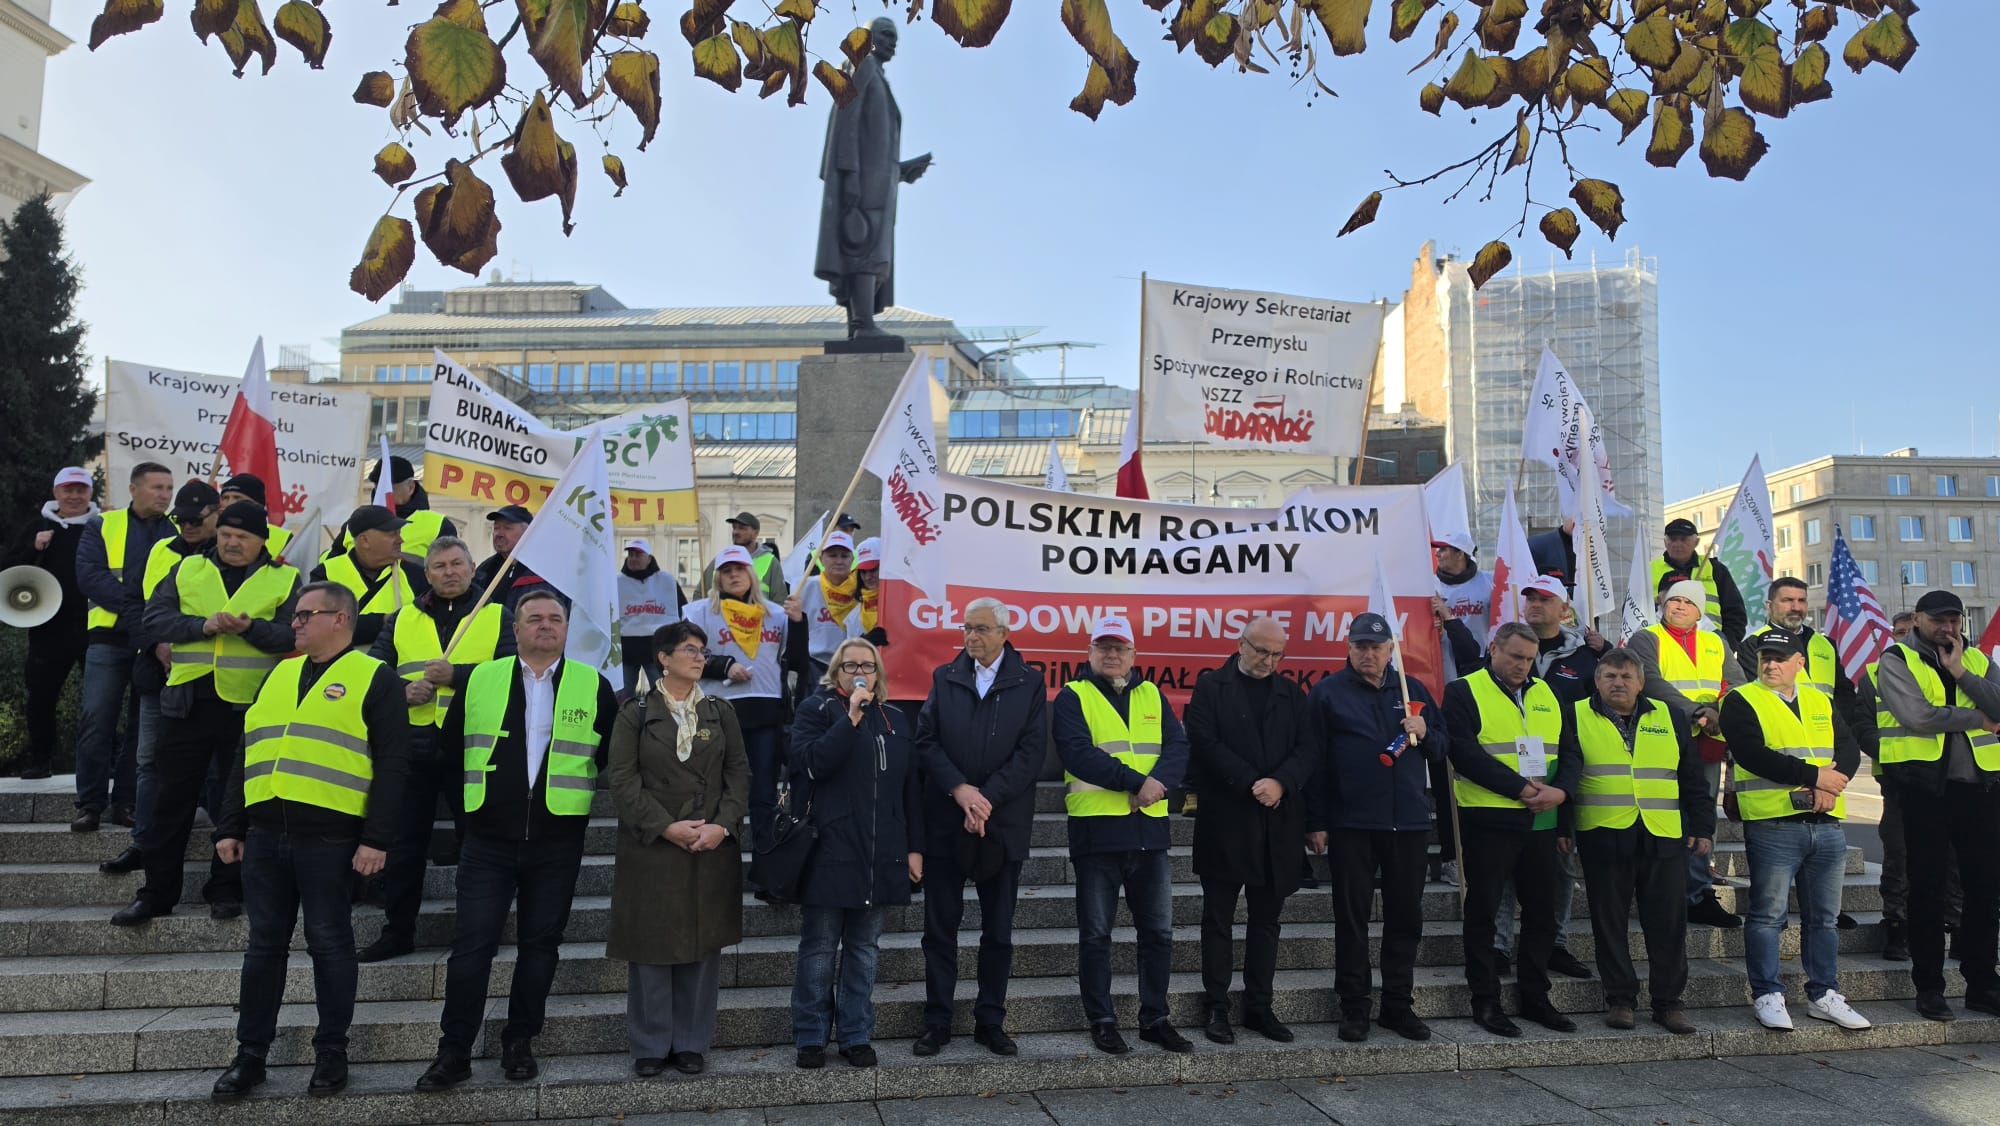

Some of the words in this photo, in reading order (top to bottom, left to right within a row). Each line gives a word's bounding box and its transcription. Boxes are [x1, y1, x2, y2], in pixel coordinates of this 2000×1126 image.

[1172, 289, 1249, 316] Krajowy
[1255, 297, 1352, 323] Sekretariat
[1211, 328, 1308, 353] Przemysłu
[148, 370, 230, 399] Krajowy
[1153, 354, 1268, 385] Spożywczego
[1273, 367, 1279, 383] i
[1285, 368, 1363, 391] Rolnictwa
[197, 408, 294, 434] Przsłu
[456, 398, 529, 436] BURAKA
[118, 431, 220, 456] Spożywcz
[276, 447, 357, 468] Rolnictwa
[428, 422, 548, 466] CUKROWEGO
[943, 492, 1142, 540] POLSKIM
[1042, 543, 1301, 575] POMAGAMY
[1589, 535, 1610, 600] olnictwa
[908, 598, 1128, 635] GŁDOW
[1304, 611, 1409, 642] MAY
